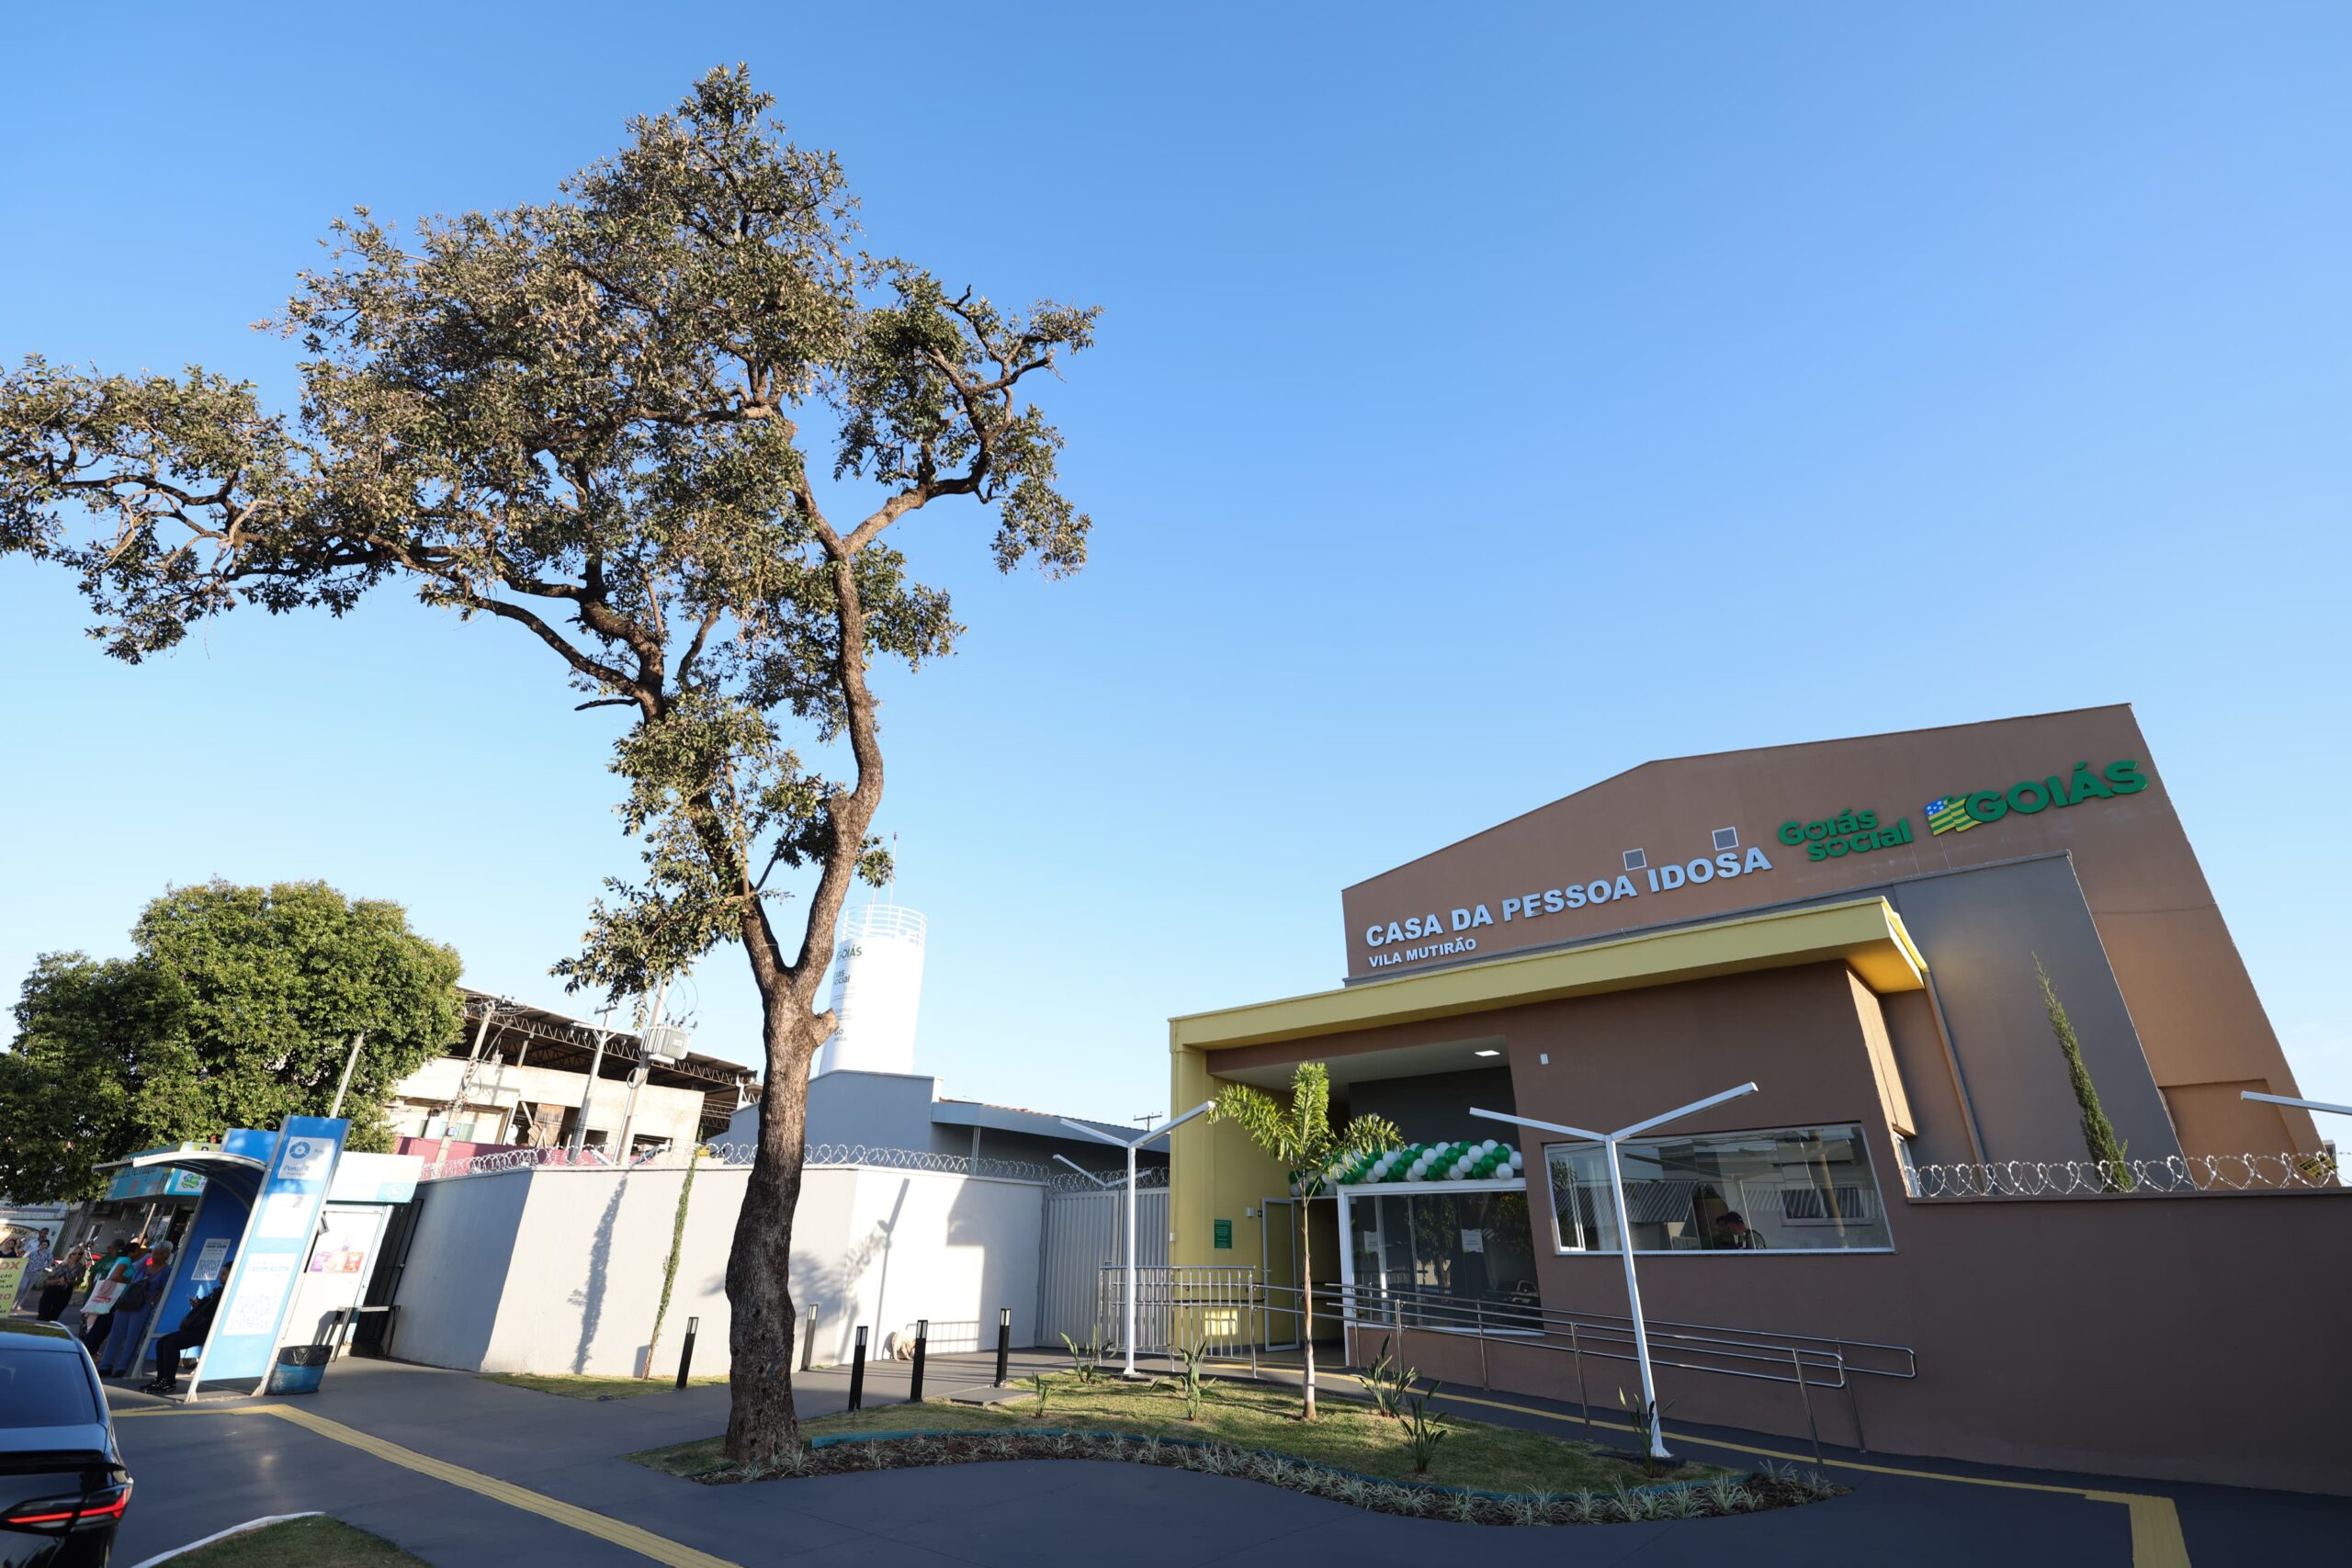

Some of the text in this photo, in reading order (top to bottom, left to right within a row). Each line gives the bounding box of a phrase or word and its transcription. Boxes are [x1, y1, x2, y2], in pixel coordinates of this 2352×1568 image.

[1964, 760, 2148, 823] GOIÁS
[1778, 807, 1878, 845] Goiás
[1808, 818, 1914, 862] social
[1365, 847, 1773, 947] CASA DA PESSOA IDOSA
[1369, 937, 1476, 967] VILA MUTIRÃO
